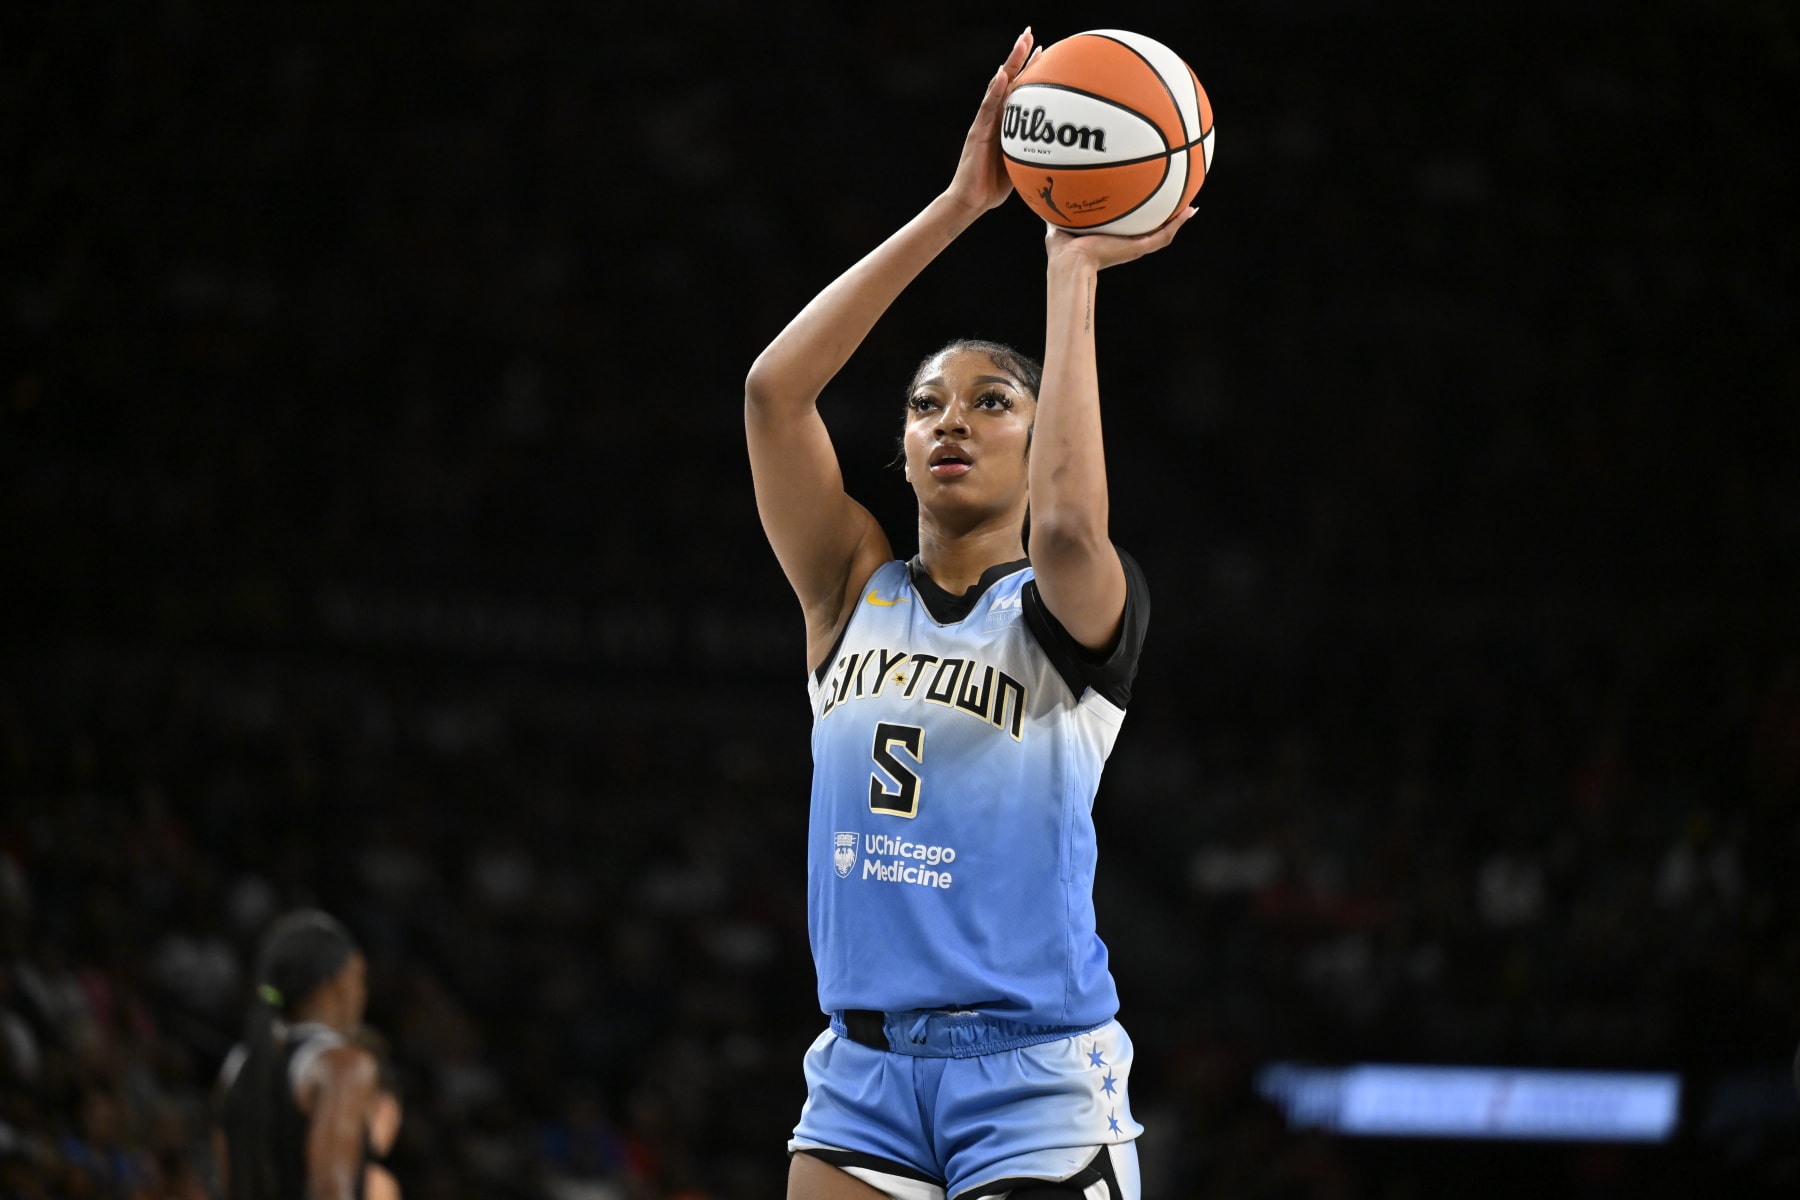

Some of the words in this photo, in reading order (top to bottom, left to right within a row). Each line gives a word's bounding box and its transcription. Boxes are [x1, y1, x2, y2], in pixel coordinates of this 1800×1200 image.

[1003, 103, 1105, 152] Wilson
[869, 721, 925, 819] 5
[865, 834, 956, 866] UChicago
[862, 859, 953, 889] Medicine
